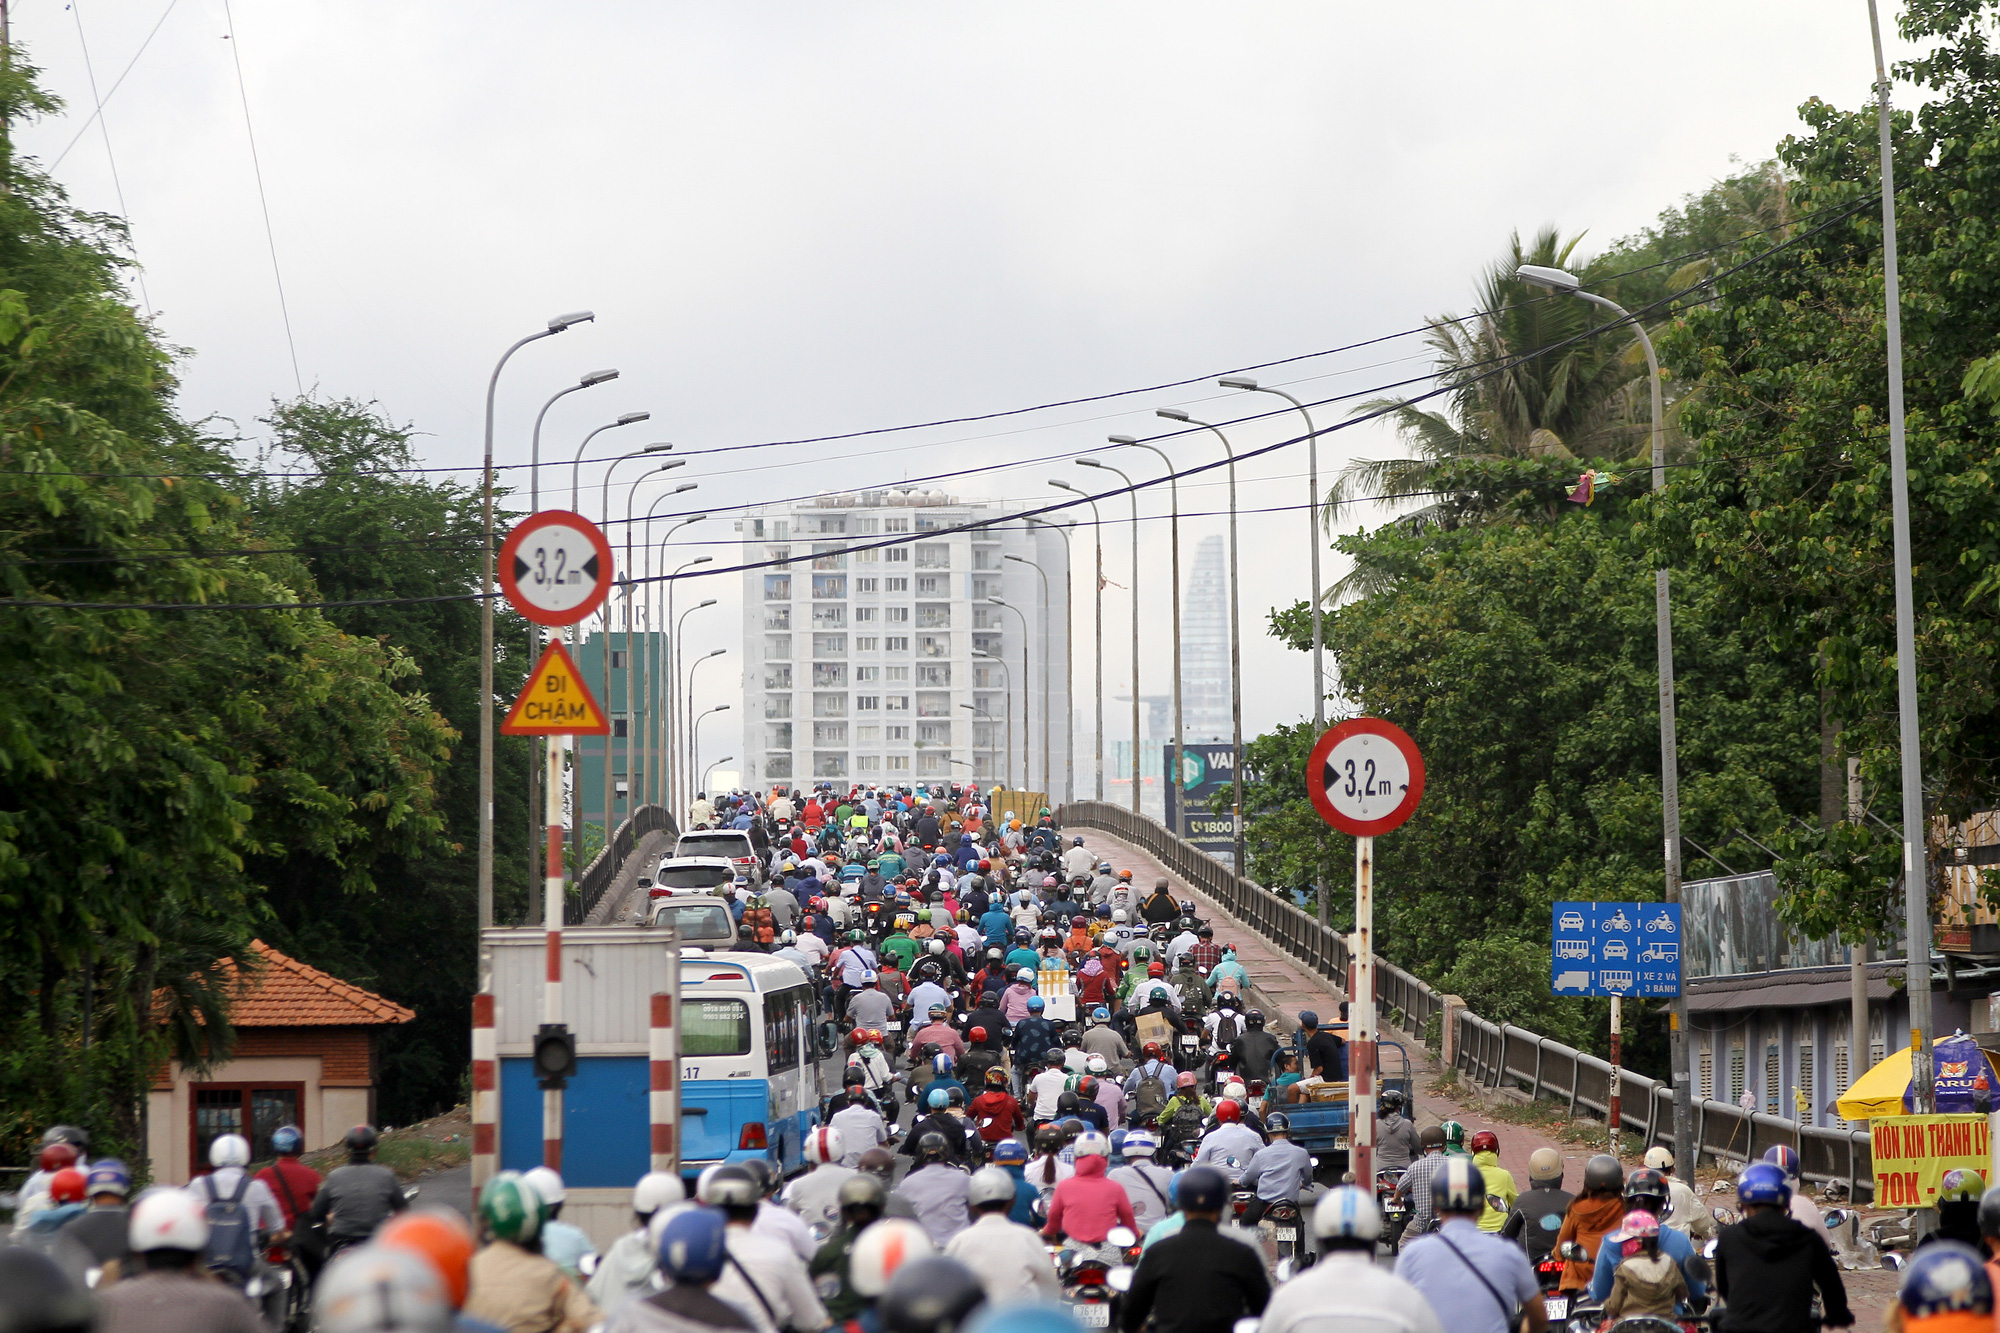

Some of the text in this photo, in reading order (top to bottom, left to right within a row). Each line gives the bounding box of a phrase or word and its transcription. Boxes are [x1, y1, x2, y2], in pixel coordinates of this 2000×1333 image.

[546, 675, 567, 693] ĐI
[1203, 821, 1233, 833] 1800
[1643, 970, 1677, 981] XE 2 VÀ
[1645, 982, 1676, 993] 3 BÁNH
[1934, 1079, 1975, 1088] ARU
[1874, 1117, 1988, 1165] NÓN XỊN THANH LÝ
[1878, 1172, 1921, 1206] 70K
[1547, 1310, 1565, 1319] 71.7
[1079, 1316, 1107, 1327] 77.32
